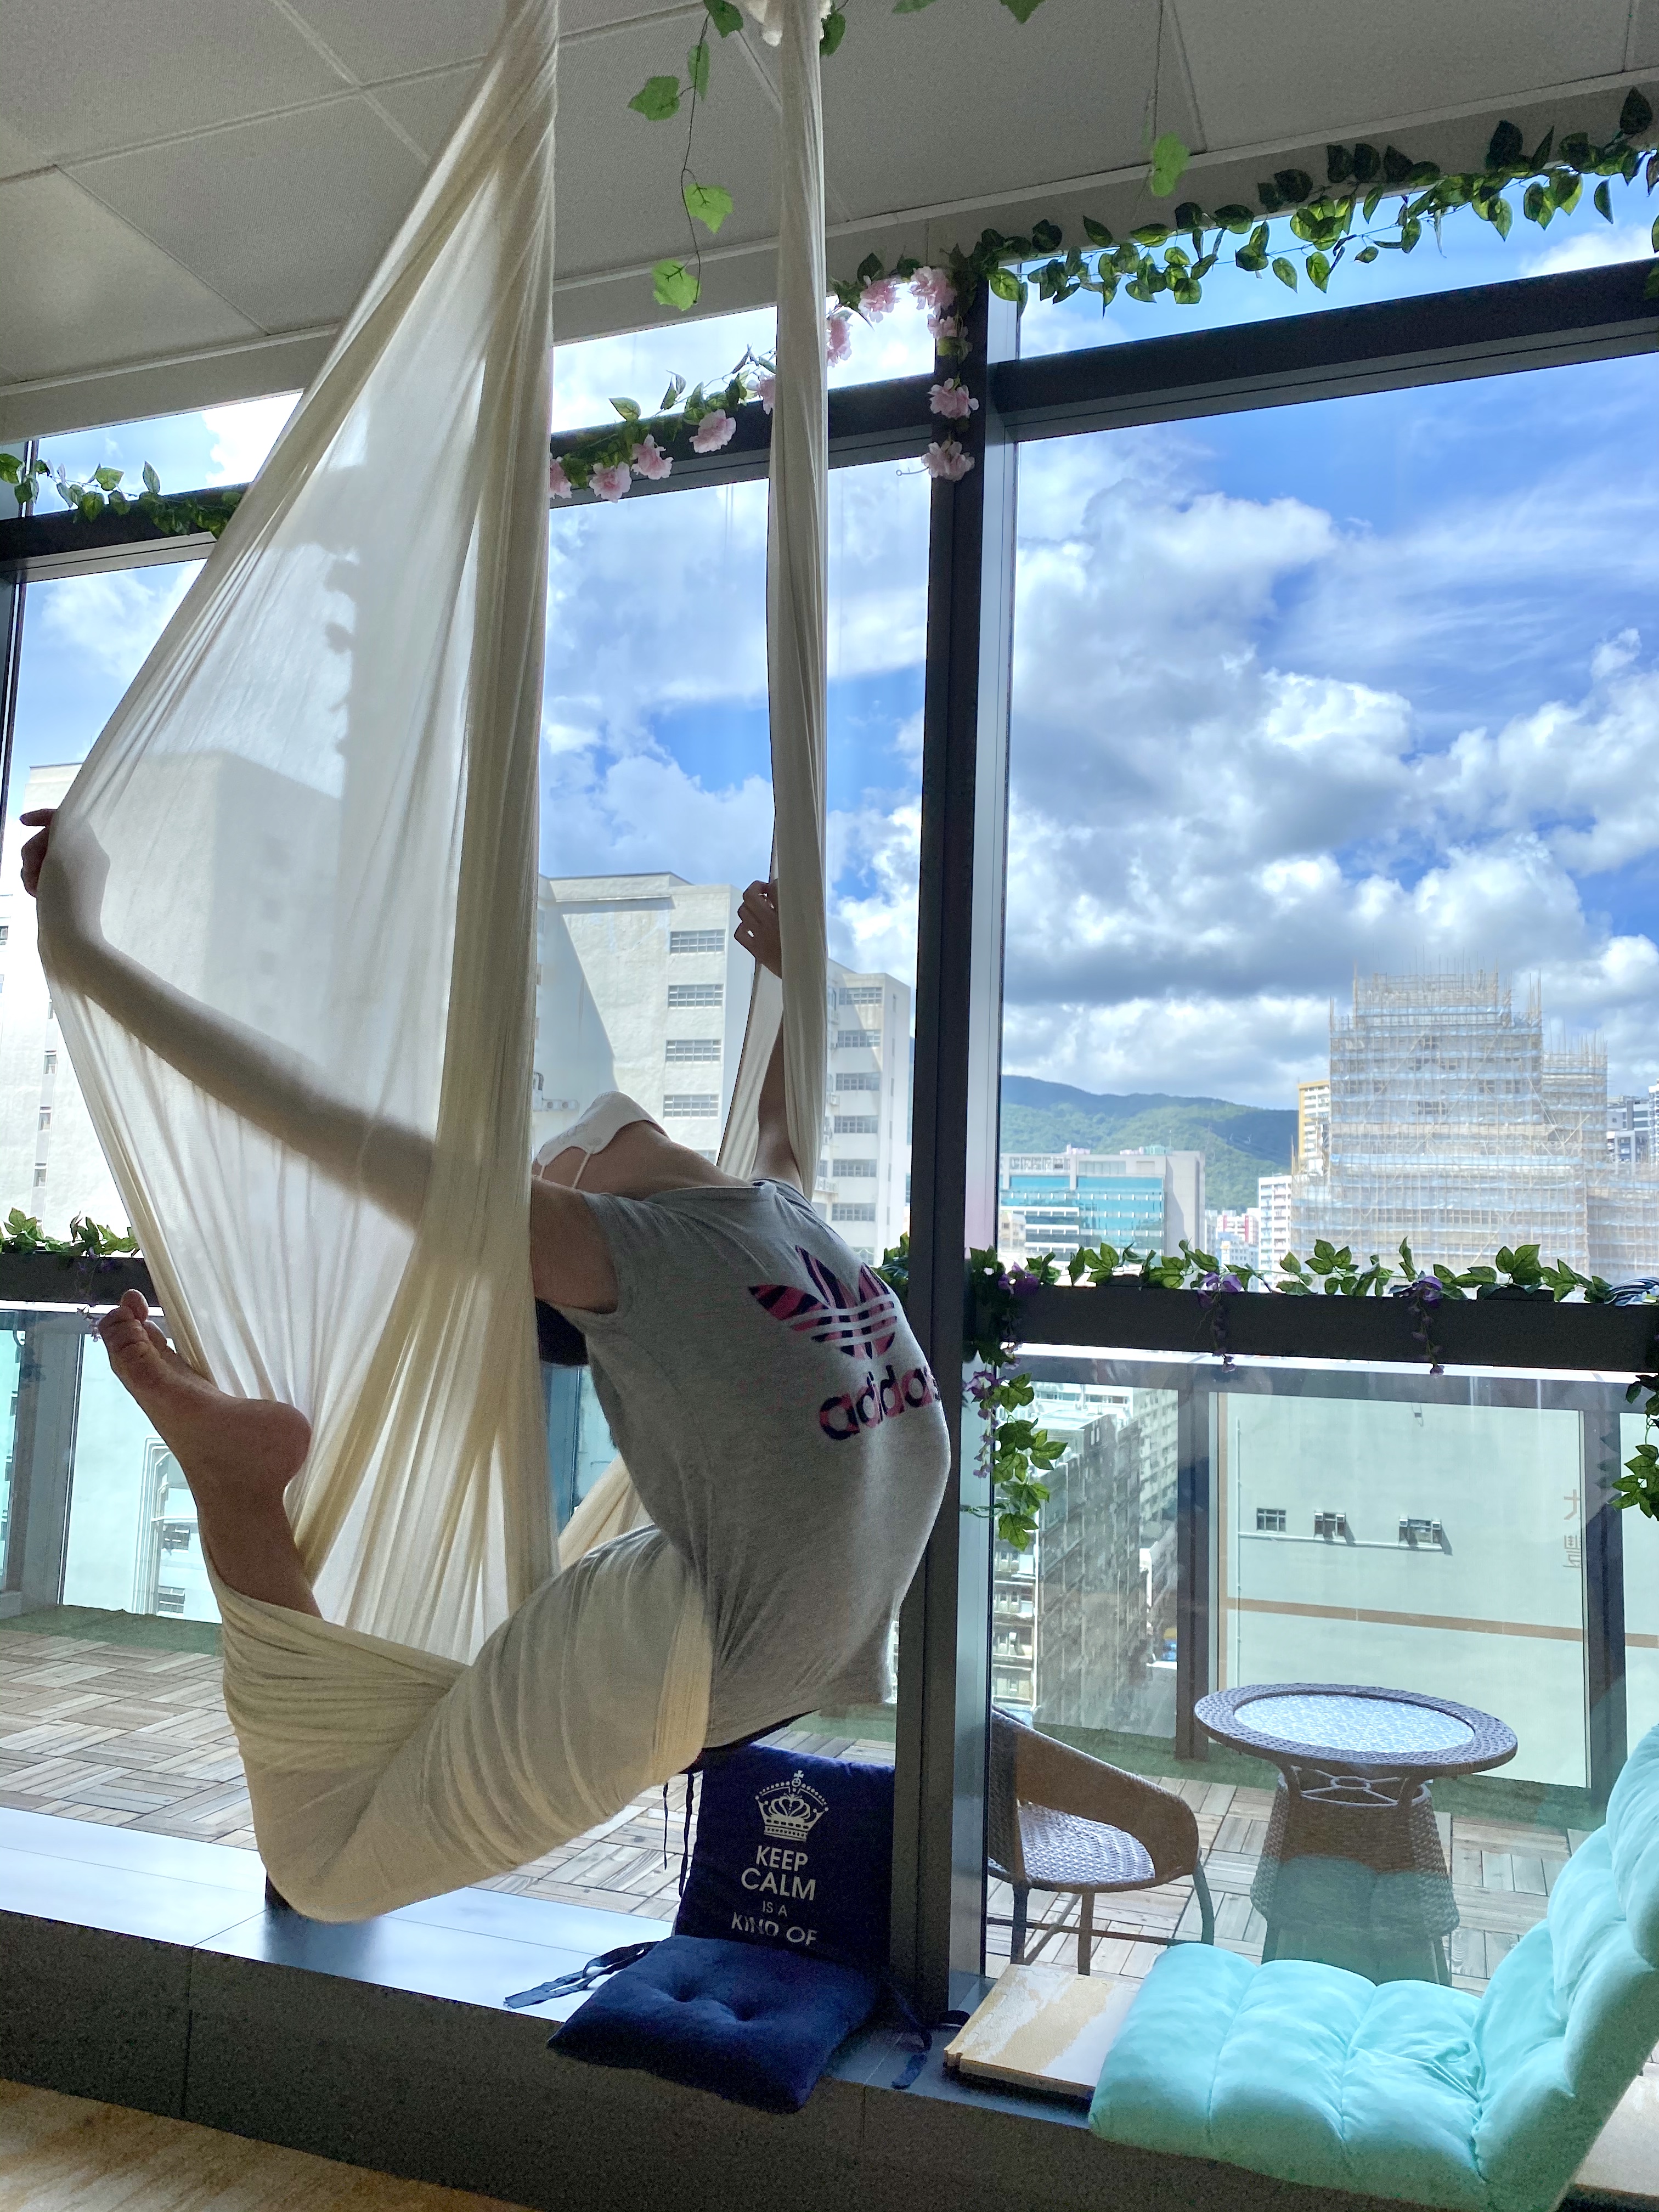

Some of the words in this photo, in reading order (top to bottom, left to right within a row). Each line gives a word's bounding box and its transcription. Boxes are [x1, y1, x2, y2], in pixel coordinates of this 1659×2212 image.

[755, 1845, 808, 1871] KEEP
[741, 1867, 816, 1901] CALM
[762, 1900, 774, 1914] IS
[777, 1904, 787, 1917] A
[731, 1911, 779, 1937] KIND
[786, 1926, 817, 1945] OF
